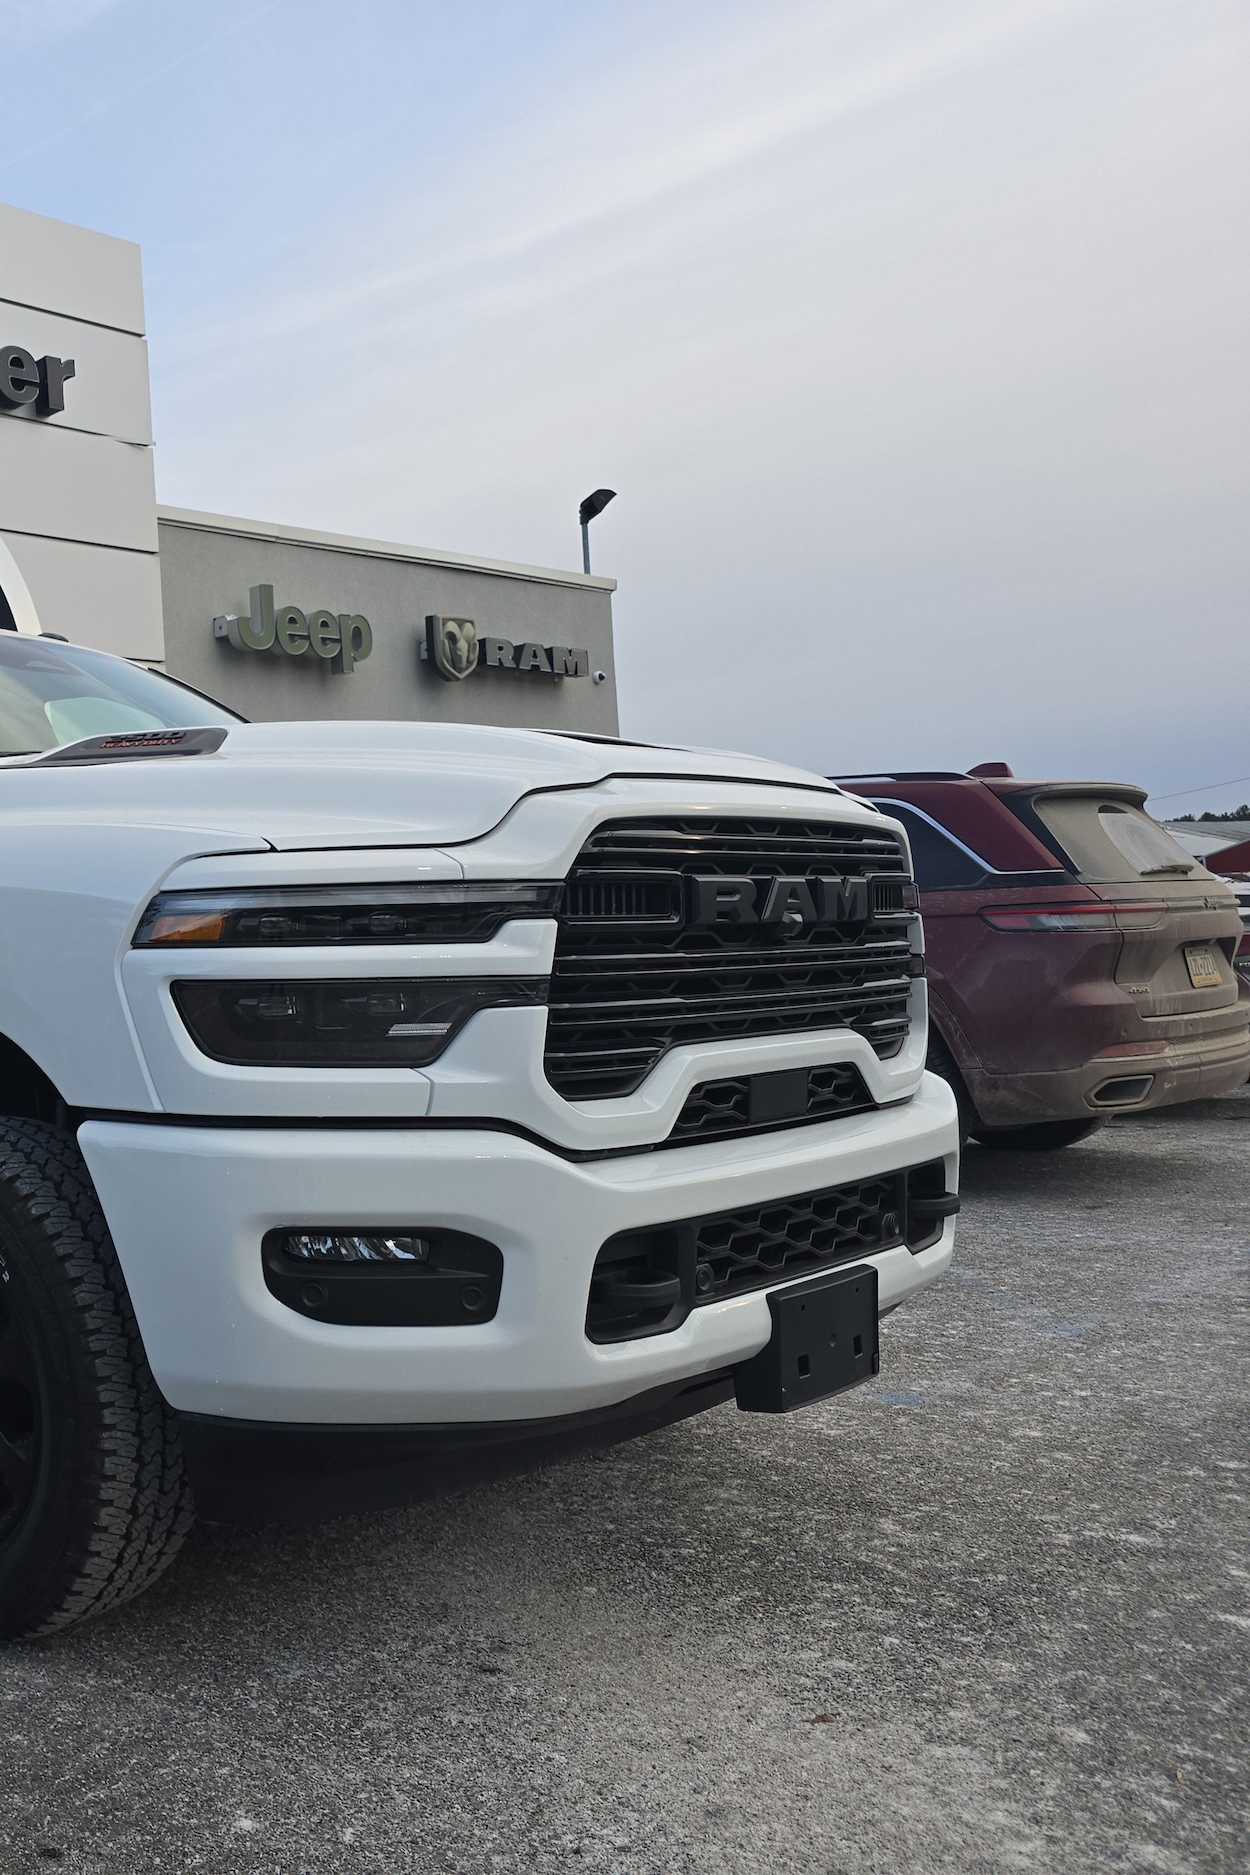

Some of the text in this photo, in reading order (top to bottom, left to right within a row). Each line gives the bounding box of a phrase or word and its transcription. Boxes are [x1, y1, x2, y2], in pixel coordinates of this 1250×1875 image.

[227, 584, 372, 674] Jeep
[480, 637, 589, 678] RAM
[691, 875, 869, 923] RAM
